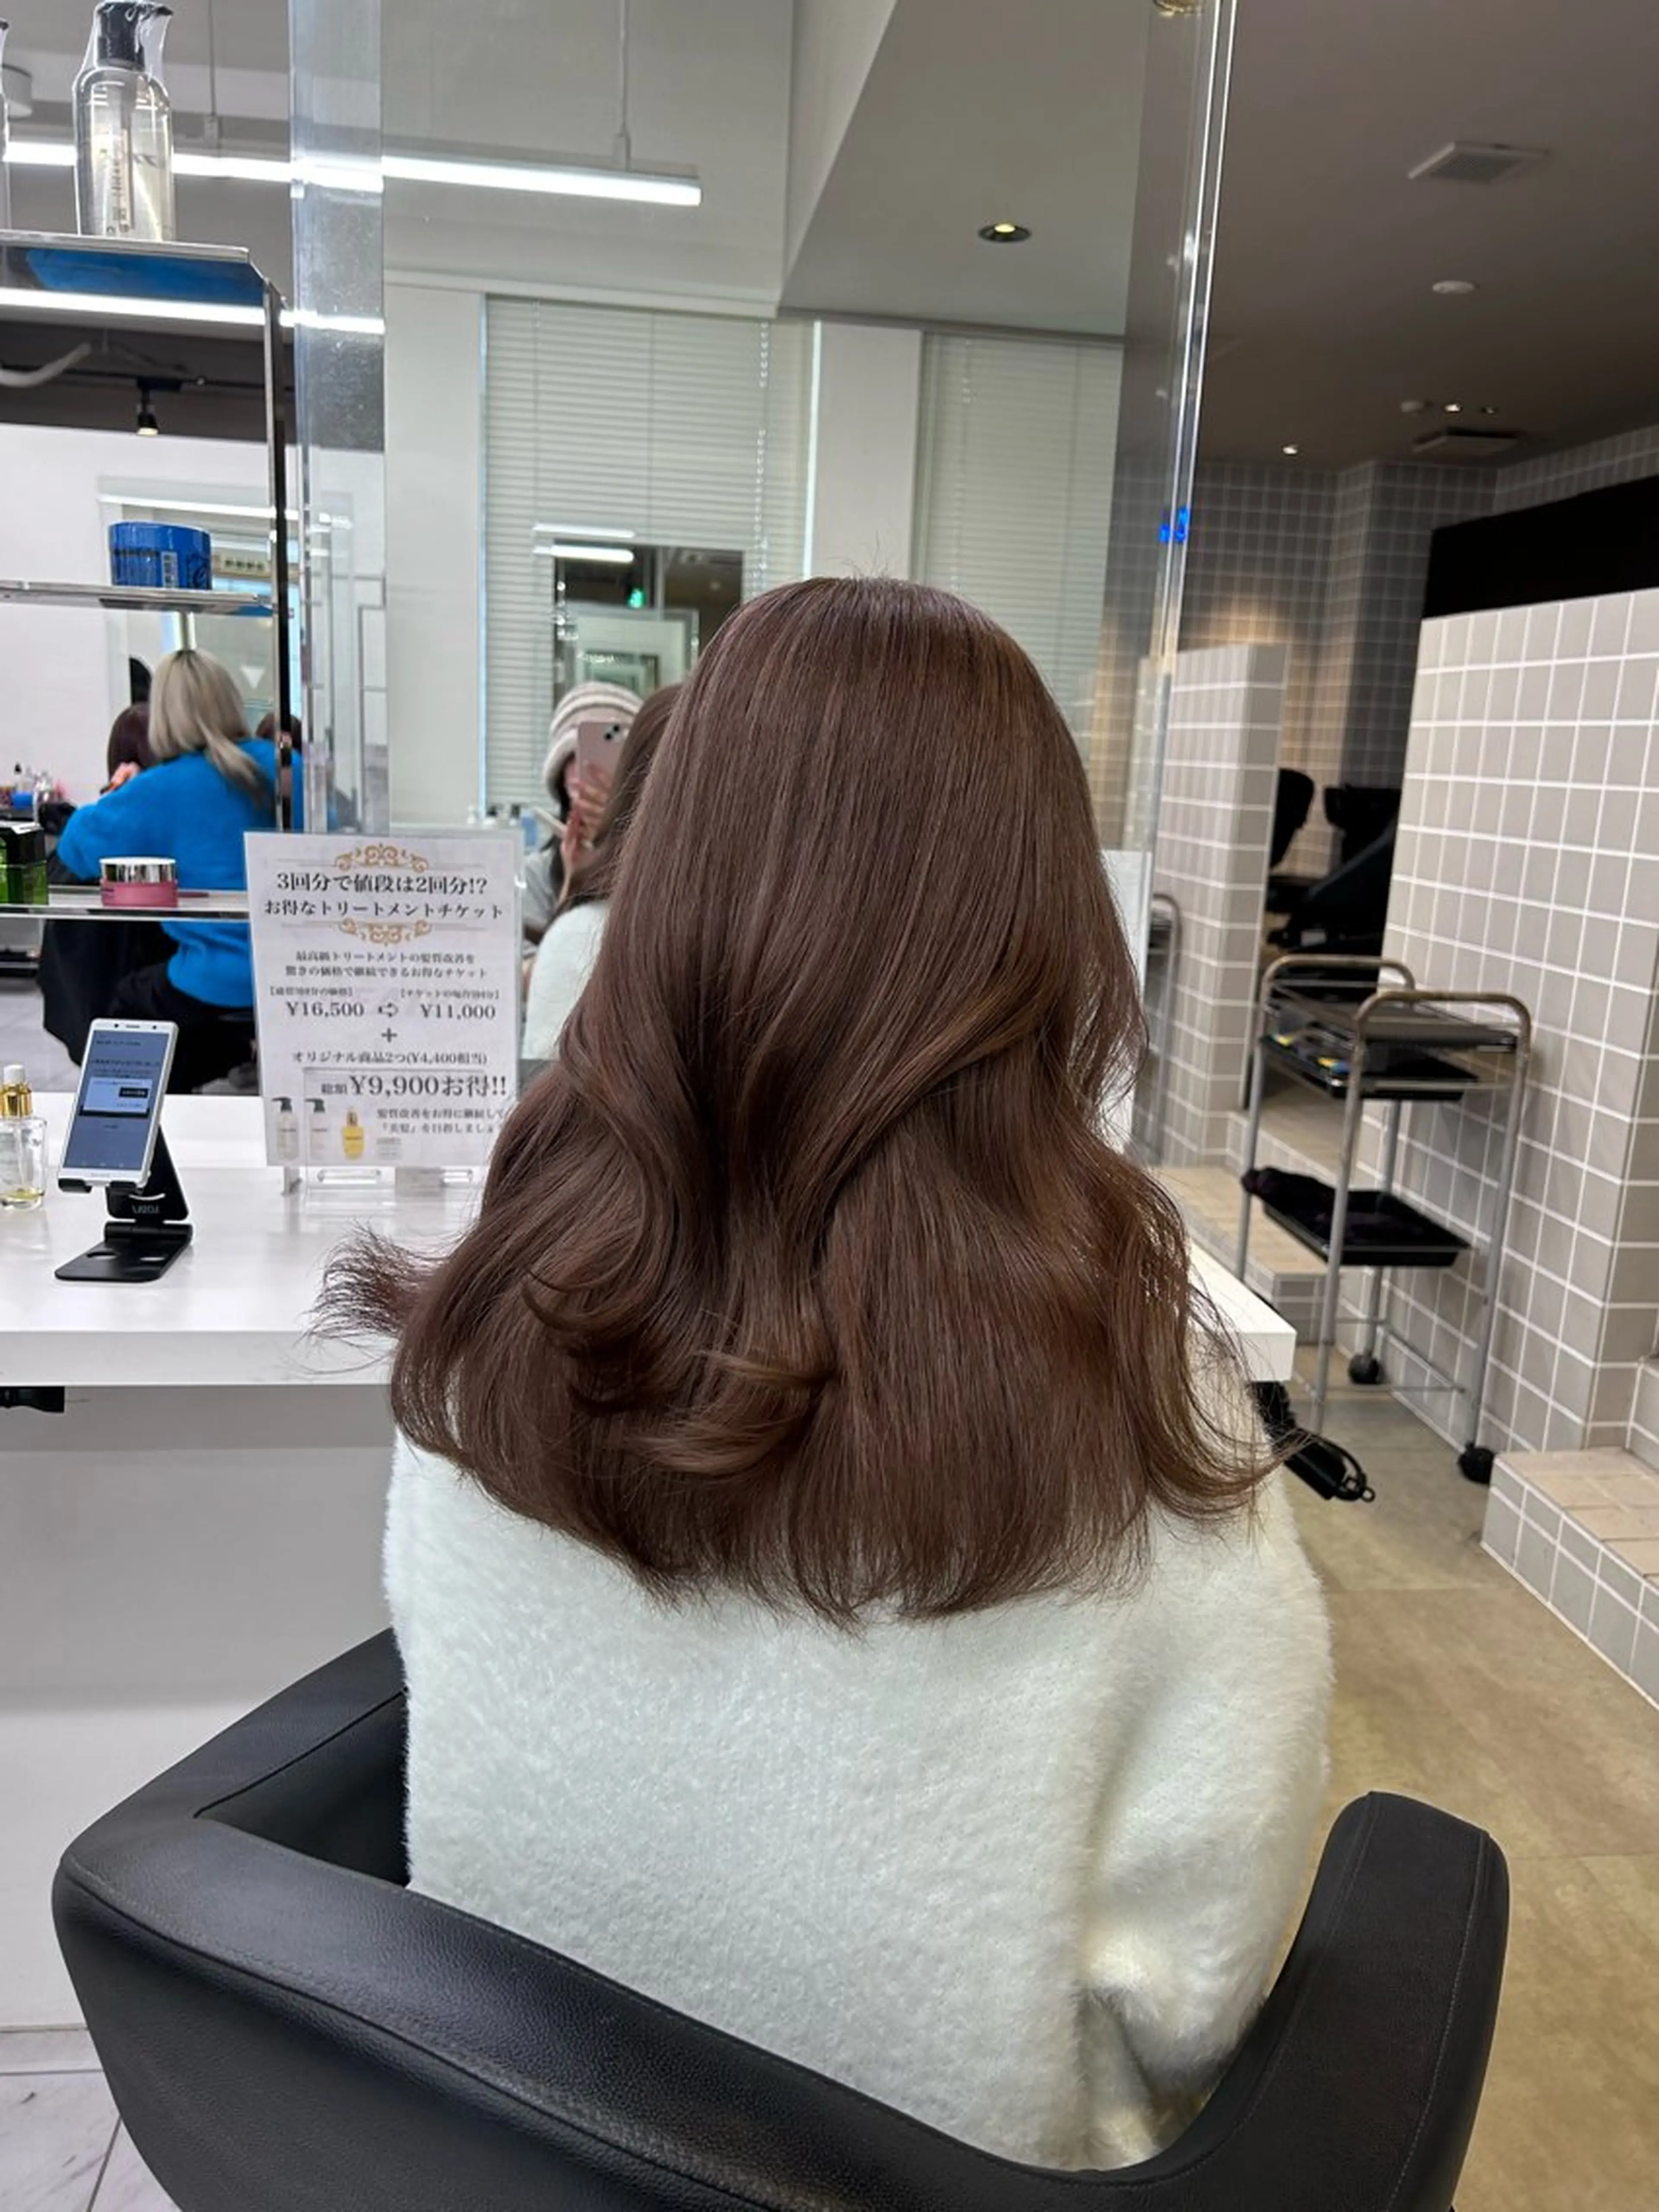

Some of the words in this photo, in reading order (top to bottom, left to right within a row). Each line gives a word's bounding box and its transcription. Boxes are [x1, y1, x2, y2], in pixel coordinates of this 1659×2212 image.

[264, 899, 502, 920] お得なトリートメントチケット
